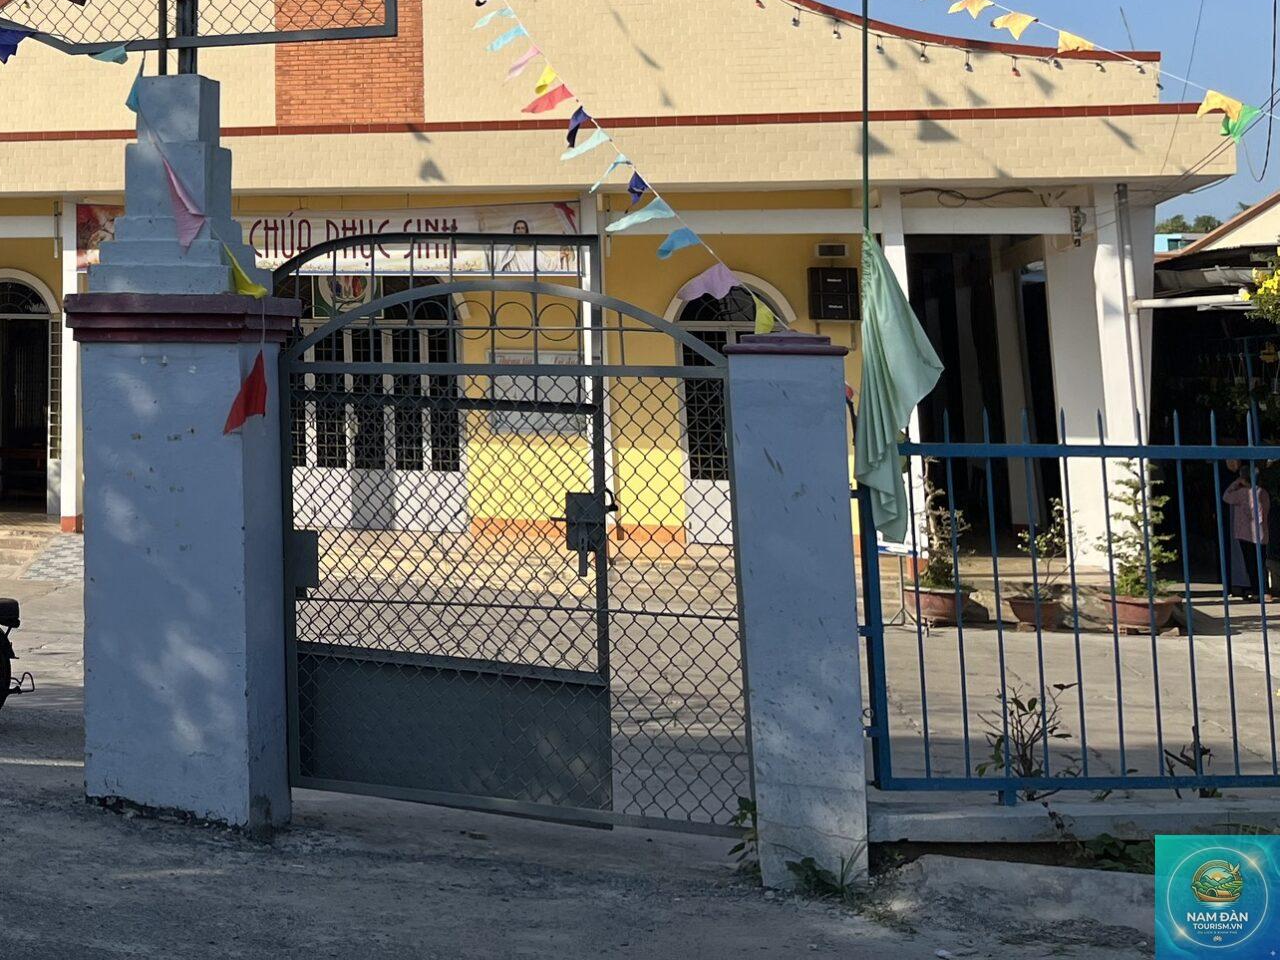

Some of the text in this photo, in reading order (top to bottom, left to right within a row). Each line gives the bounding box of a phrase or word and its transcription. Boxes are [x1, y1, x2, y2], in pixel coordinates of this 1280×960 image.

[249, 210, 459, 267] CHÚA PHỤC SINH
